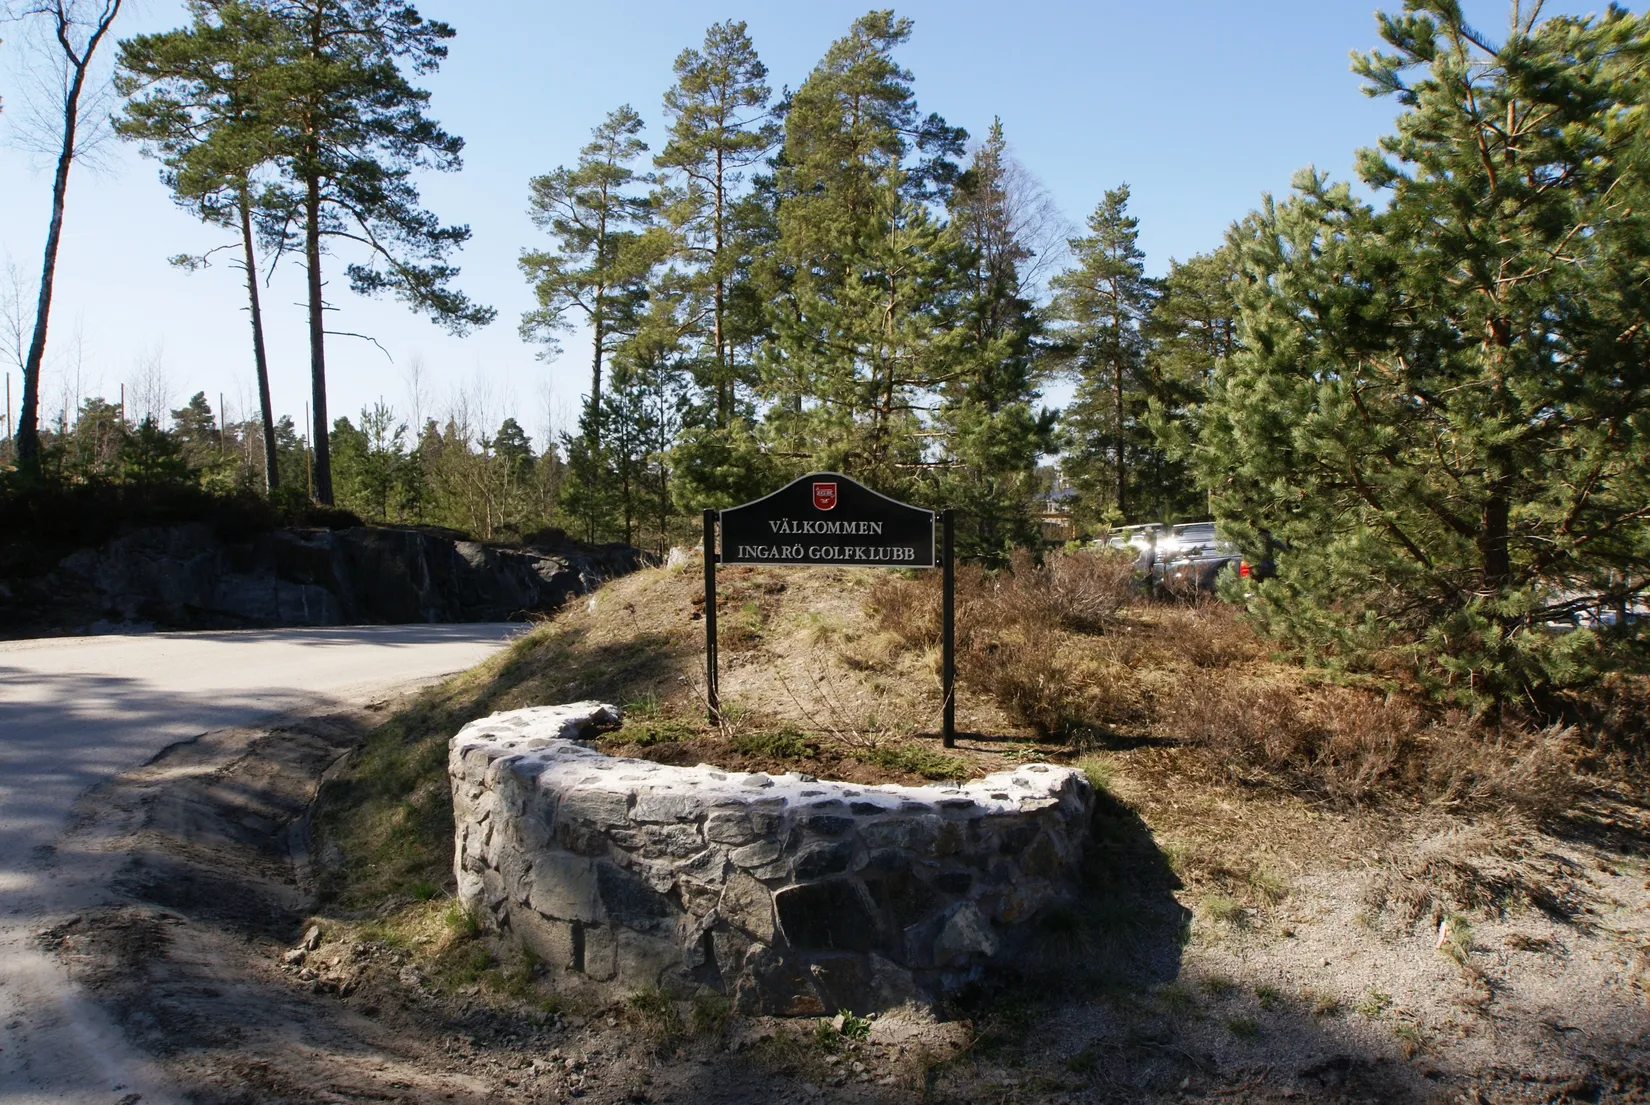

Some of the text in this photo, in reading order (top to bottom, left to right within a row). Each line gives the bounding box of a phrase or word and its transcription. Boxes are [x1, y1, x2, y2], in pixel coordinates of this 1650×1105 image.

[768, 518, 884, 535] VÄLKOMMEN
[737, 543, 916, 561] INGARÖ GOLFKLUBB
